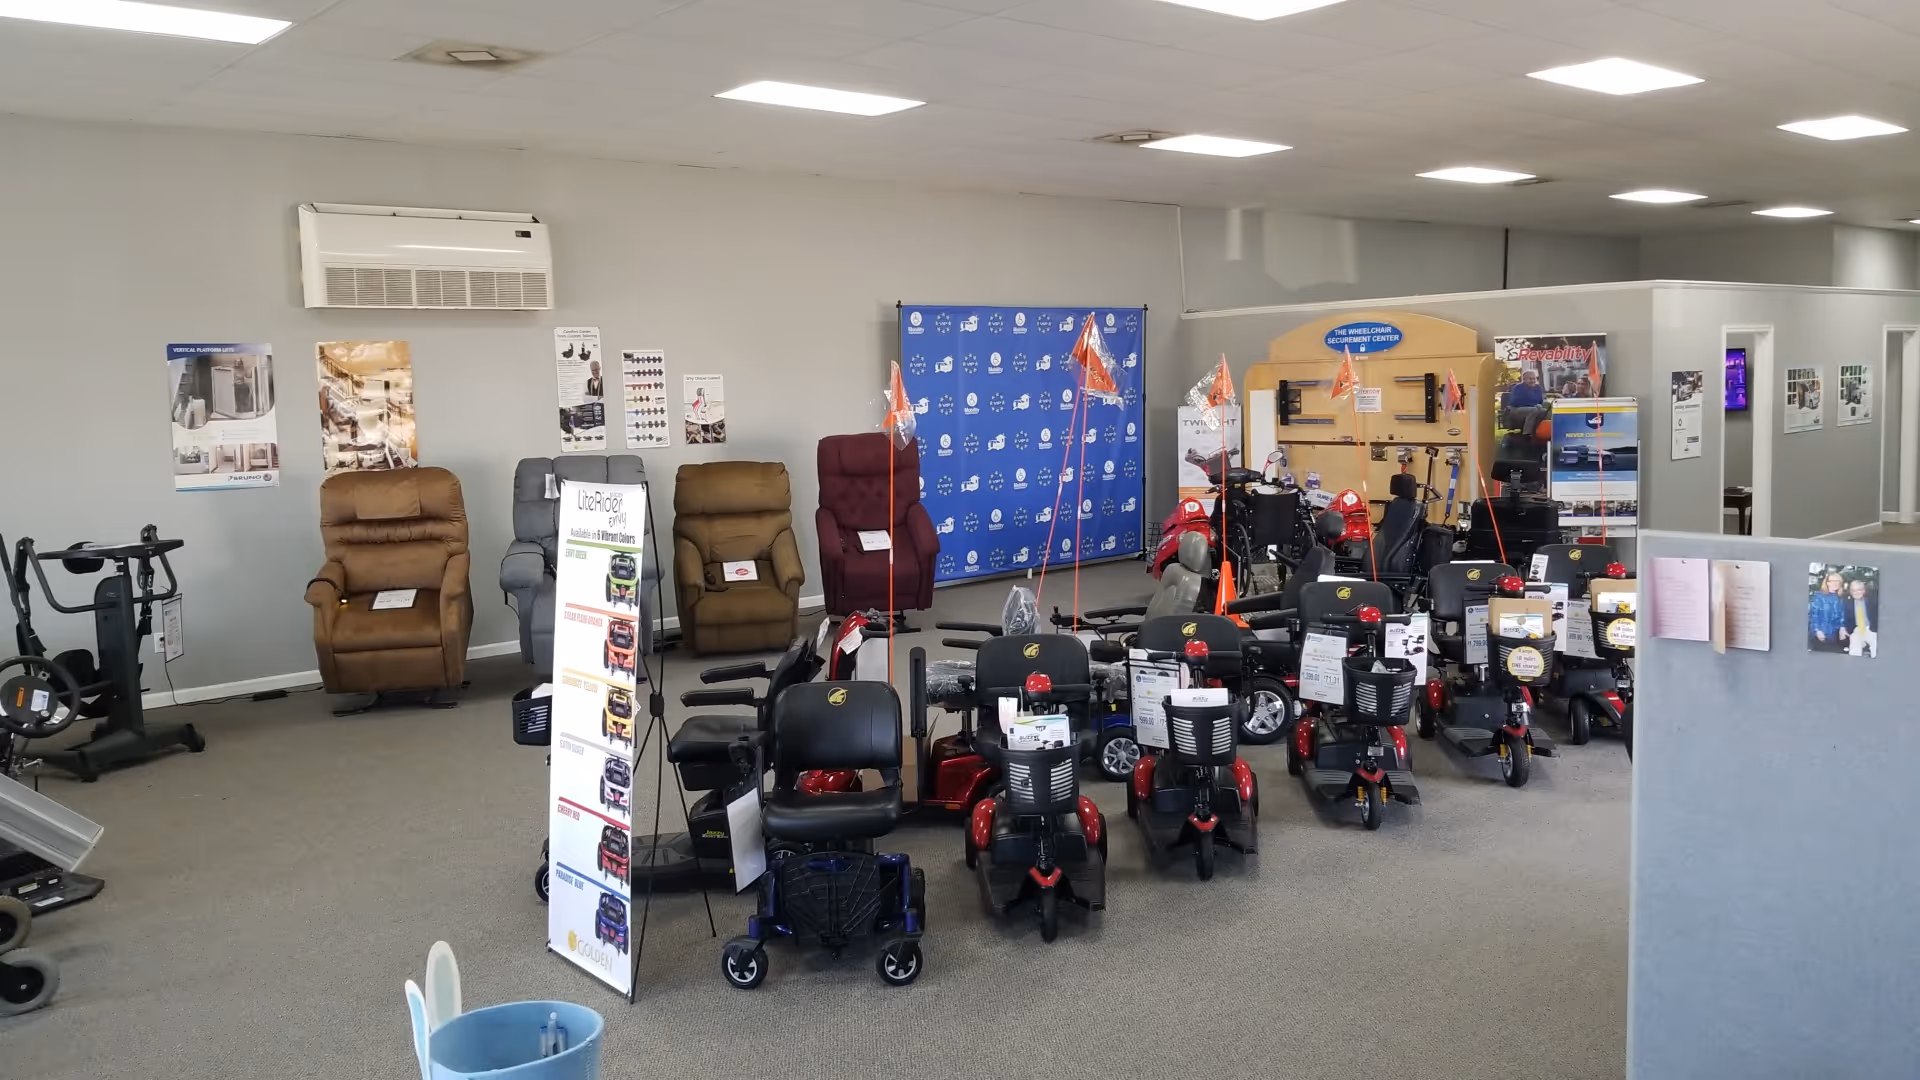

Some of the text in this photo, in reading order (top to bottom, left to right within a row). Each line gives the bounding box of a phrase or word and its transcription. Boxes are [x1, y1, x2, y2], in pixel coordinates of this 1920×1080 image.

[1348, 327, 1392, 335] WHEELCHAIR
[1327, 336, 1370, 344] SECUREMENT
[1518, 346, 1592, 361] Revability
[578, 490, 622, 513] LiteRider
[570, 528, 591, 539] Available
[601, 531, 619, 543] Vibrant
[619, 532, 636, 545] Colors
[557, 804, 581, 821] CHERRY RED
[556, 868, 584, 891] PARADISE BLUE
[577, 938, 613, 971] GOLDEN
